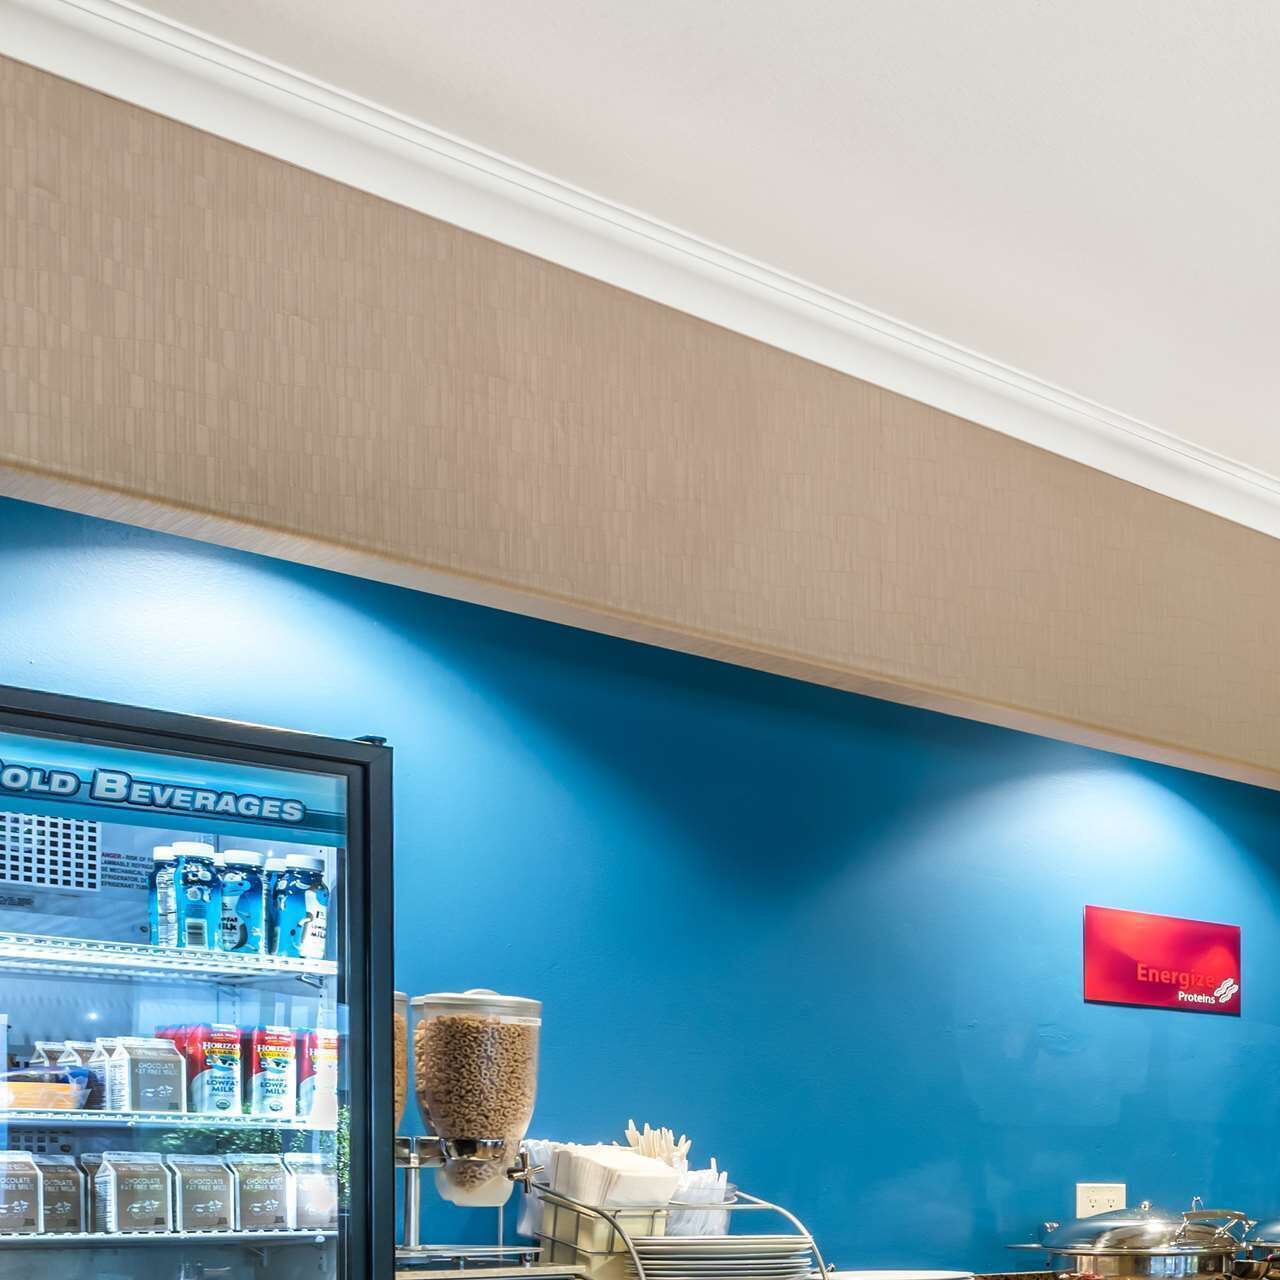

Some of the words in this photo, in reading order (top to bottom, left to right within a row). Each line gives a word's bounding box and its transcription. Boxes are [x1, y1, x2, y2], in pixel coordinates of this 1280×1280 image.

[0, 766, 77, 793] OLD
[95, 768, 304, 821] BEVERAGES
[1137, 962, 1216, 990] Energize
[1178, 991, 1216, 1004] Proteins
